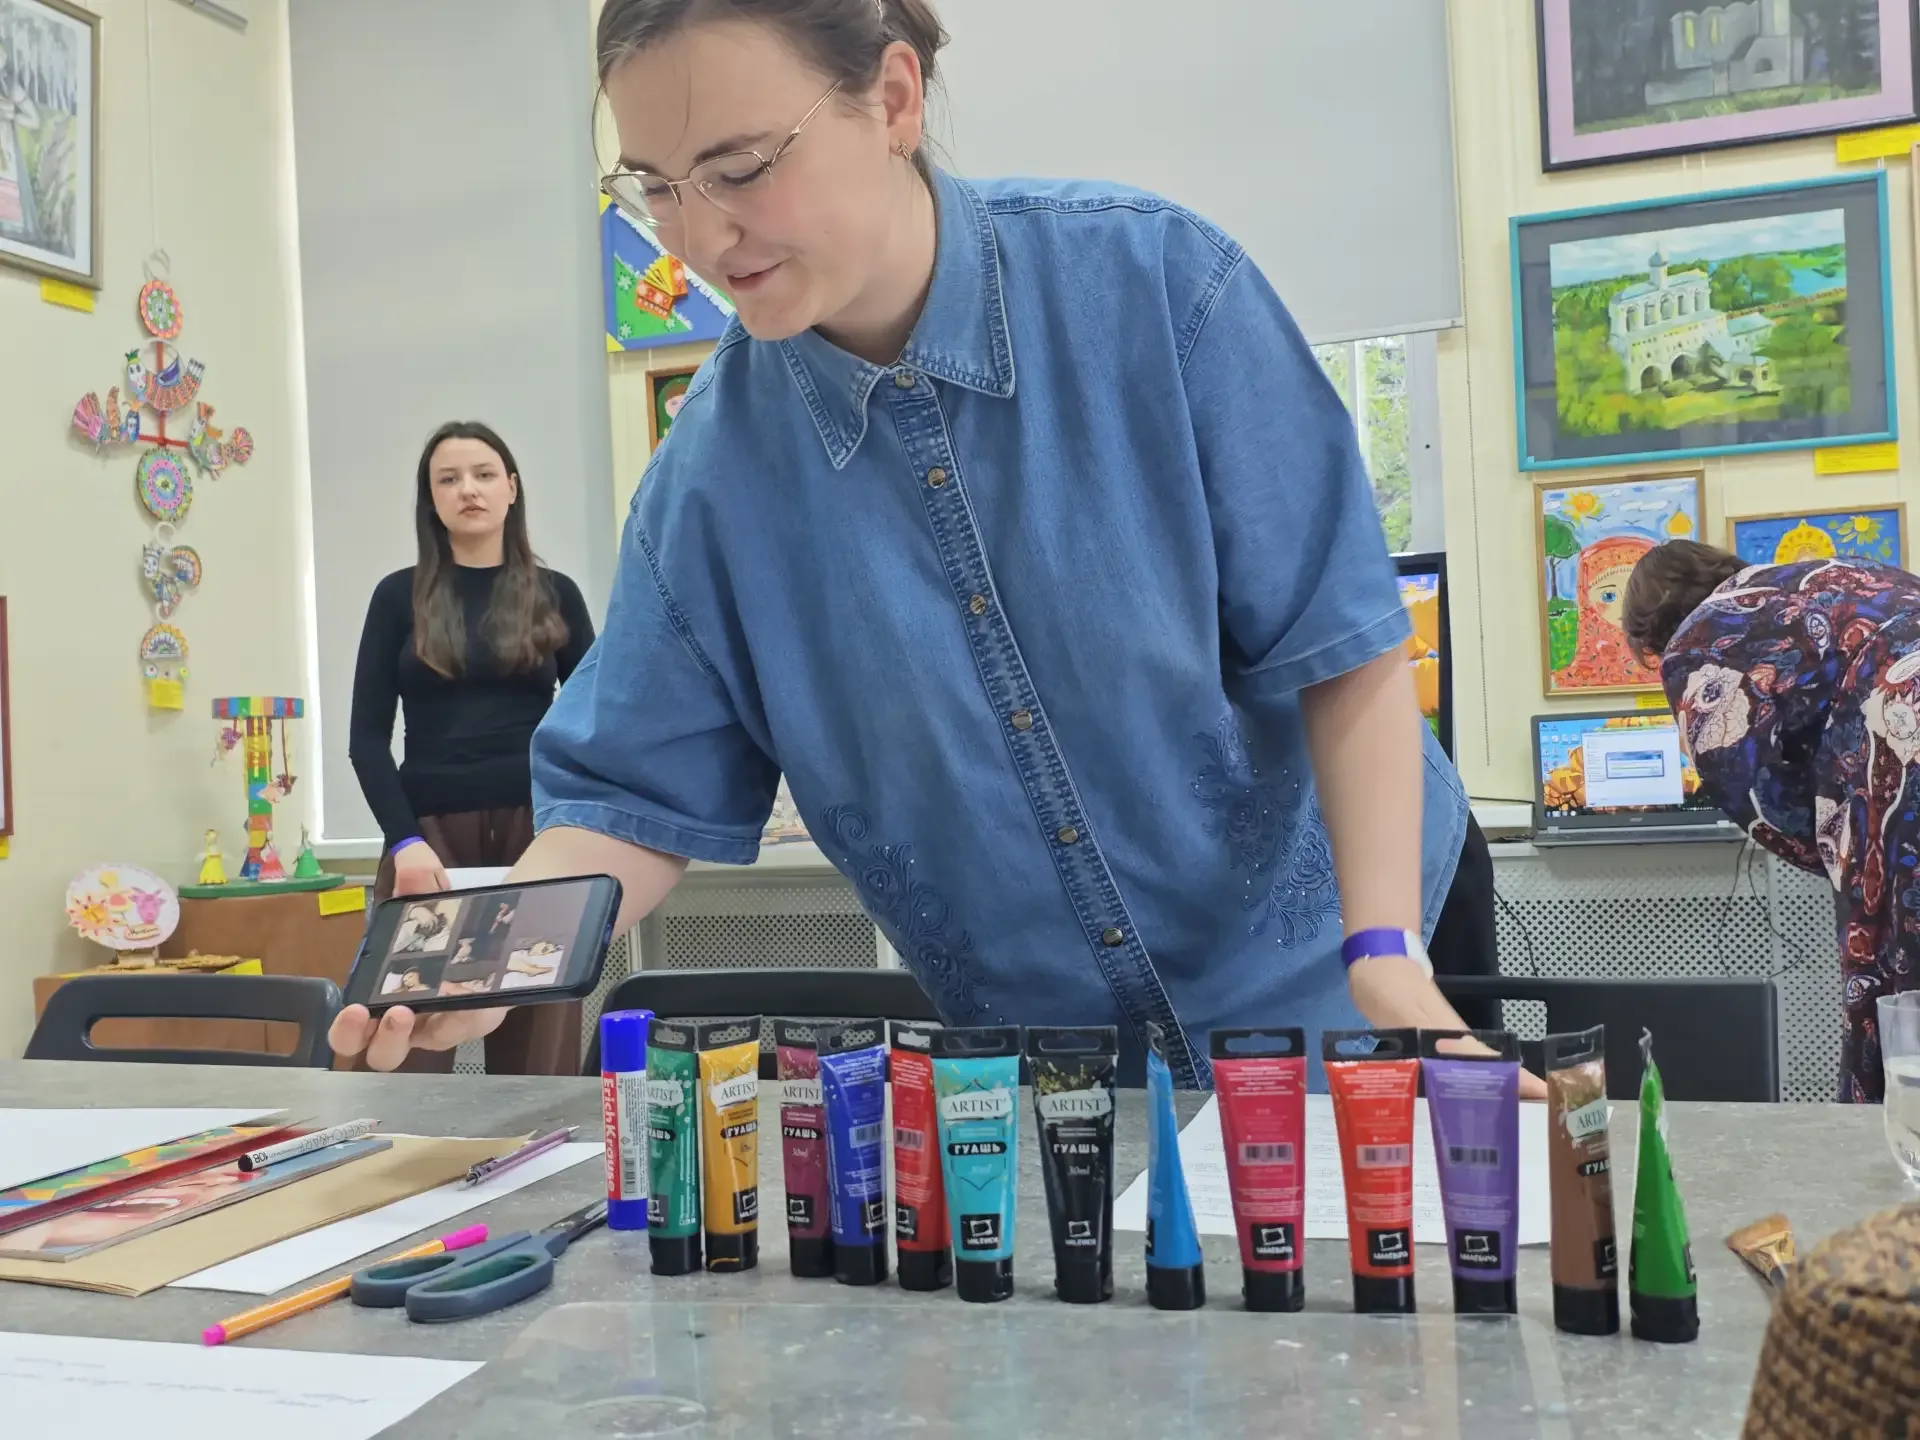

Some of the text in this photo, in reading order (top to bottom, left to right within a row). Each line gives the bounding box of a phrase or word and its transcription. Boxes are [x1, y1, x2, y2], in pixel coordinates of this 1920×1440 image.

[781, 1085, 821, 1099] ARTIST
[949, 1098, 1003, 1113] ARTIST
[1049, 1098, 1101, 1112] ARTIST
[1576, 1107, 1606, 1129] ARTIS
[300, 1121, 370, 1152] SKETCH&ART
[603, 1078, 617, 1192] ErichKrause
[648, 1129, 671, 1139] АШЬ
[783, 1127, 817, 1139] ГУАШЬ
[954, 1144, 1001, 1155] ГУАШЬ
[1053, 1144, 1100, 1154] ГУАШЬ
[252, 1151, 268, 1163] 108
[1585, 1161, 1611, 1175] ГУА
